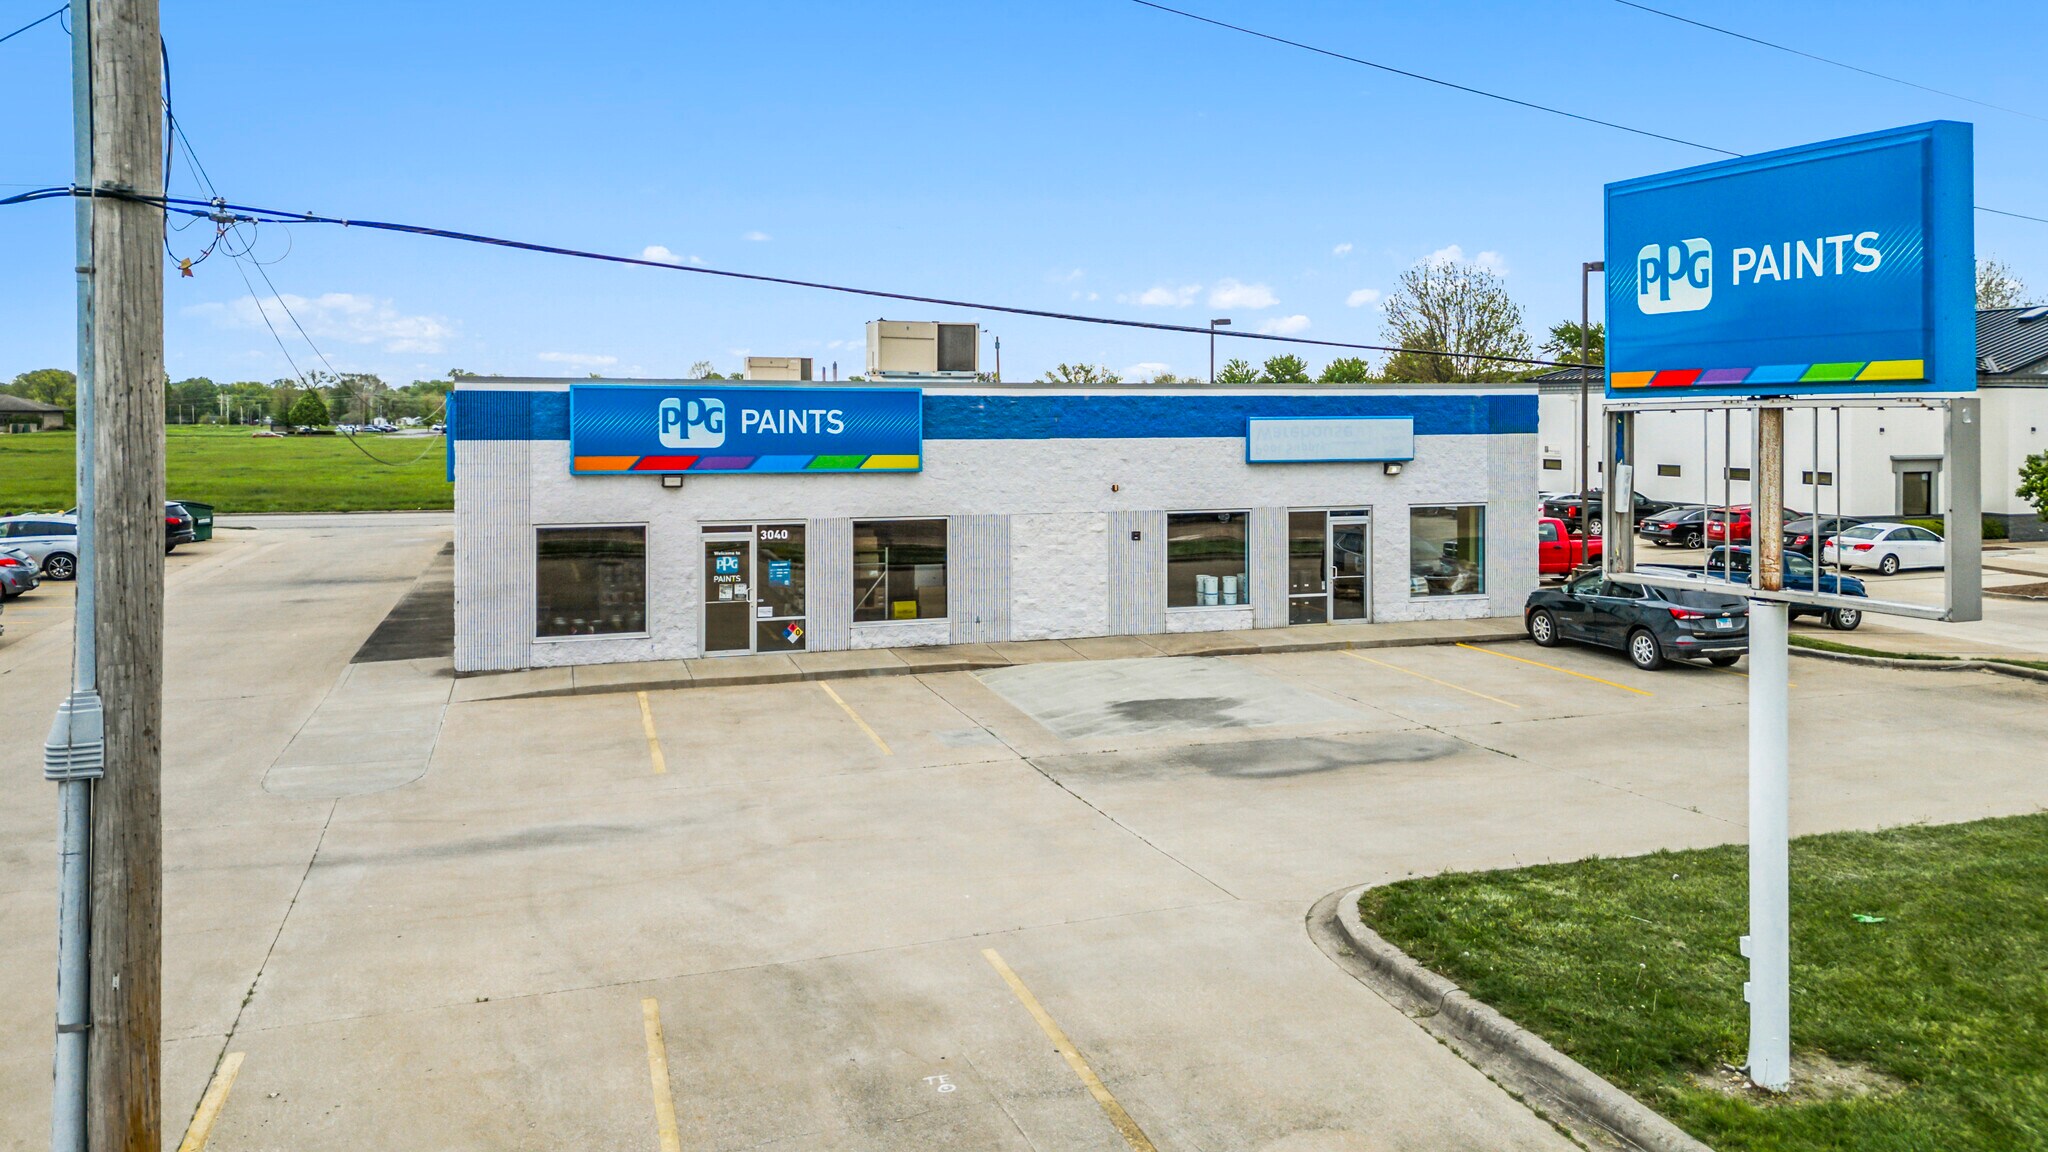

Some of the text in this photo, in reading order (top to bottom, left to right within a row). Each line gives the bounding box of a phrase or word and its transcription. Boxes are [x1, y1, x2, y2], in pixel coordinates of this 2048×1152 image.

[1640, 231, 1882, 302] PPG PAINTS
[661, 398, 845, 439] PPG PAINTS
[760, 529, 788, 540] 3040
[716, 556, 738, 571] PPG
